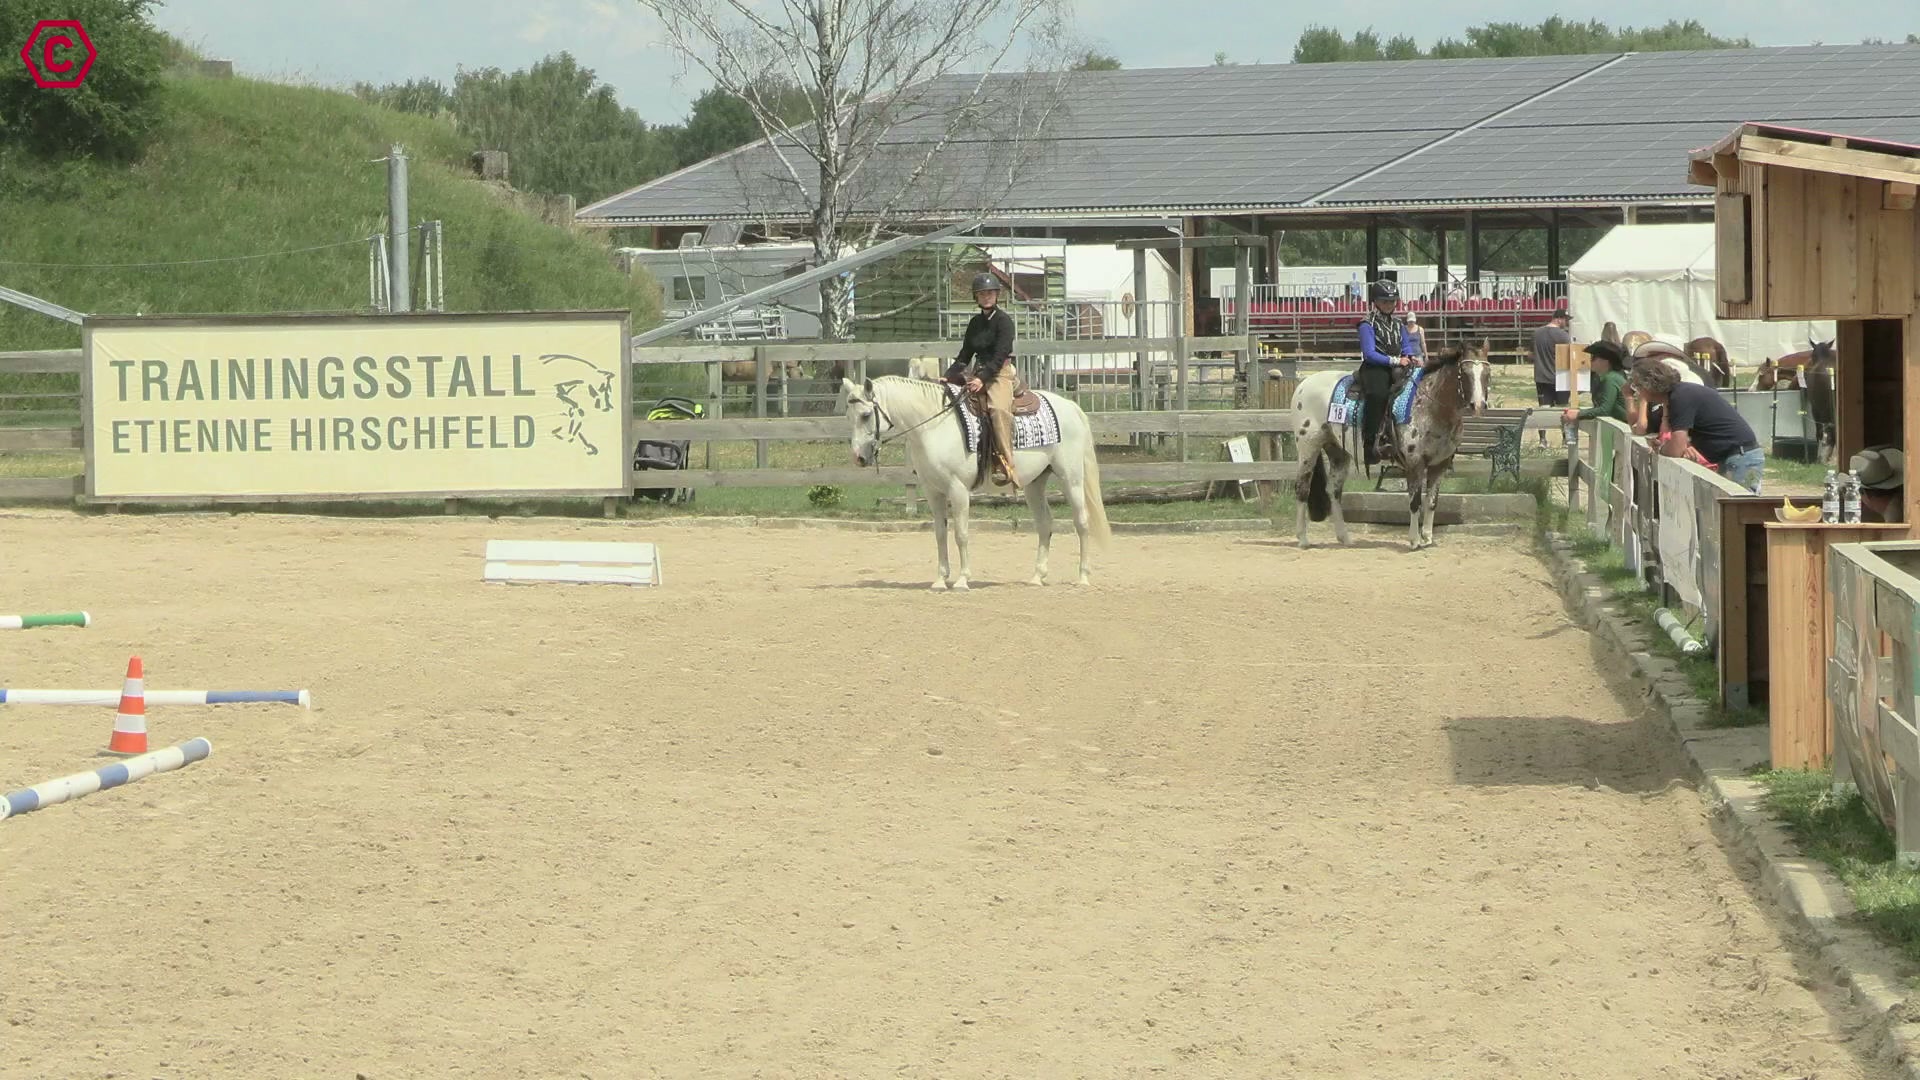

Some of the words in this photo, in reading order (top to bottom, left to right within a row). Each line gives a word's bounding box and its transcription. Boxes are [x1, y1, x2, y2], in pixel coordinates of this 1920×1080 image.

[109, 355, 536, 401] TRAININGSSTALL
[112, 418, 272, 453] ETIENNE
[290, 415, 535, 451] HIRSCHFELD
